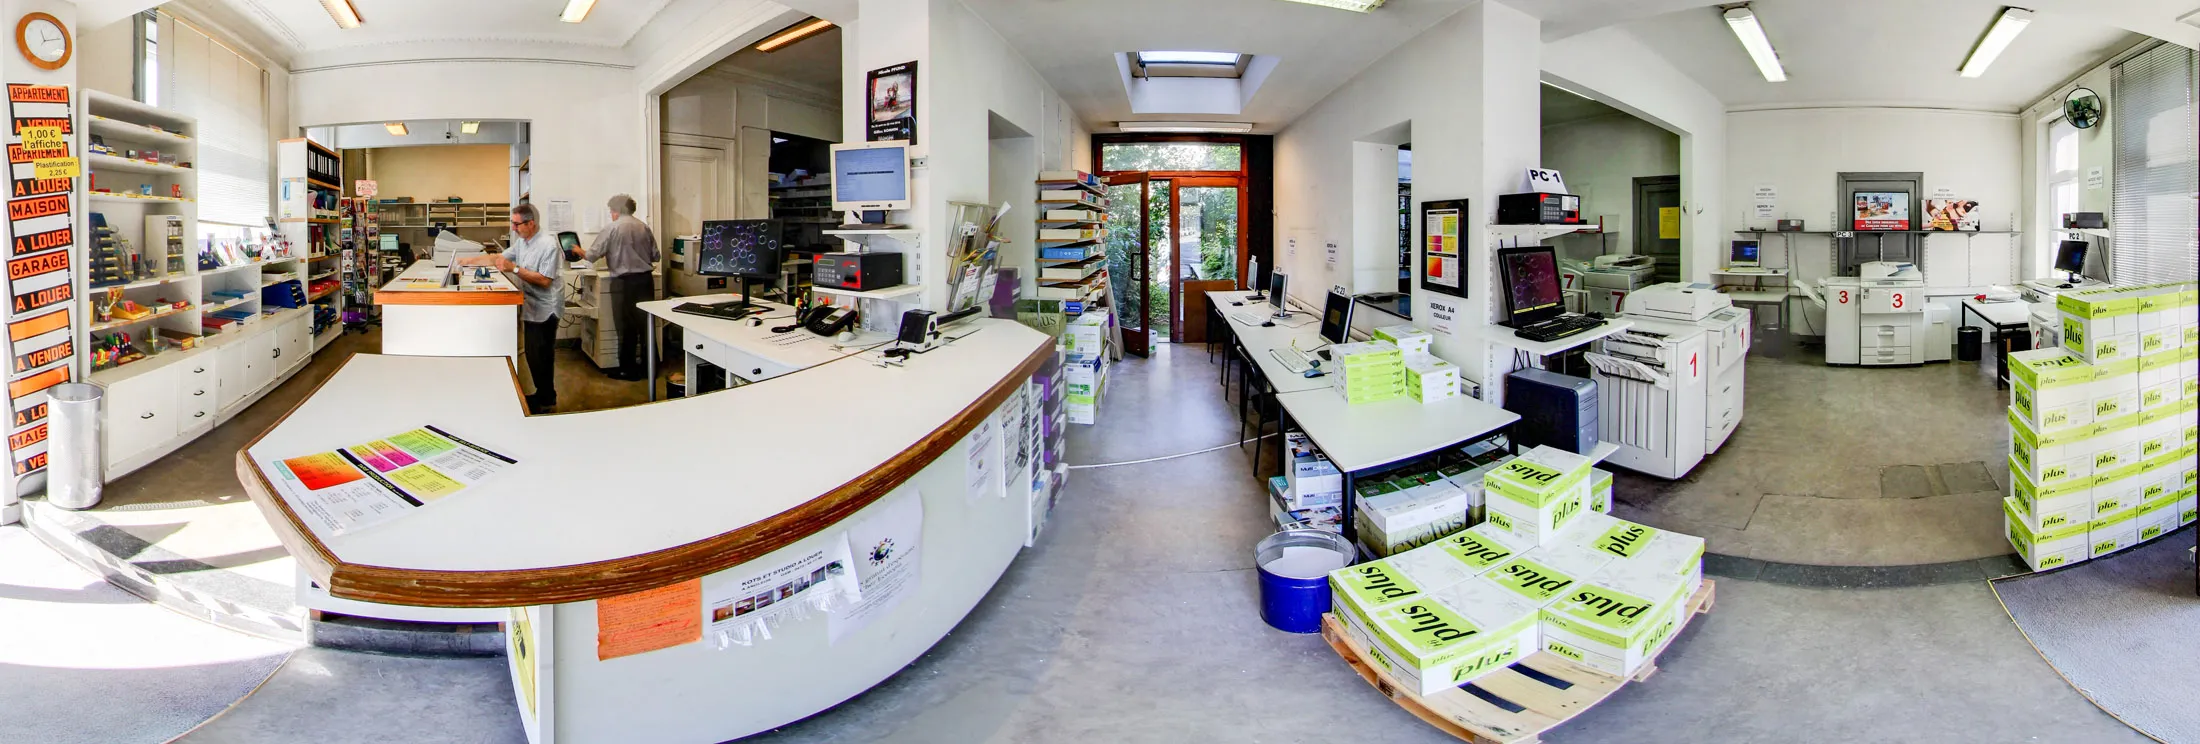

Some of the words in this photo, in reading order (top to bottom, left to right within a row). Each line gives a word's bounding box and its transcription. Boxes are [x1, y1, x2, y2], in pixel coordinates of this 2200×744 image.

[12, 87, 66, 100] APPARTEMENT
[16, 119, 23, 133] A
[27, 119, 71, 133] VENDRE
[28, 129, 48, 140] 1,00
[50, 129, 56, 138] €
[24, 140, 62, 149] l'affiche
[12, 147, 66, 160] APPARTEMENT
[1530, 169, 1549, 182] PC
[1553, 172, 1560, 183] 1
[16, 181, 26, 196] A
[30, 178, 71, 194] LOUER
[12, 198, 67, 217] MAISON
[16, 238, 26, 253] A
[30, 229, 71, 250] LOUER
[2069, 232, 2076, 240] PC
[12, 254, 67, 276] GARAGE
[1563, 274, 1574, 289] 7
[16, 297, 26, 312] A
[30, 284, 71, 308] LOUER
[1612, 291, 1626, 313] 7
[1839, 290, 1849, 304] 3
[1892, 294, 1903, 308] 3
[1430, 302, 1446, 312] XEROX
[1448, 306, 1455, 314] A4
[2092, 306, 2107, 316] plus
[2140, 302, 2153, 311] plus
[1433, 312, 1452, 321] COULEUR
[1740, 328, 1744, 348] 1
[2064, 325, 2082, 345] plus
[2143, 336, 2161, 350] plus
[16, 357, 26, 372] A
[28, 342, 72, 368] VENDRE
[2096, 344, 2116, 358] plus
[1690, 352, 1697, 378] 1
[2032, 356, 2074, 366] plus
[2040, 376, 2056, 386] plus
[2184, 382, 2197, 396] plu
[2015, 390, 2031, 412] plus
[2144, 393, 2161, 406] plus
[2096, 402, 2117, 416] plus
[16, 412, 26, 426] A
[2044, 414, 2066, 428] plus
[12, 427, 48, 448] MAIS
[2185, 429, 2197, 441] plu
[2038, 438, 2055, 447] plus
[2144, 442, 2161, 456] plus
[2014, 442, 2029, 464] plus
[16, 462, 26, 475] A
[2096, 455, 2116, 468] plus
[1505, 462, 1562, 482] plus
[2042, 469, 2065, 482] plus
[2184, 472, 2197, 485] plu
[1486, 480, 1501, 491] plus
[2094, 476, 2109, 486] plus
[2040, 490, 2056, 498] plus
[2144, 487, 2162, 499] plus
[1552, 497, 1580, 530] plus
[2098, 500, 2117, 514] plus
[1488, 513, 1511, 530] plus
[2042, 516, 2065, 528] plus
[1392, 516, 1463, 555] cyclus
[2036, 535, 2052, 543] plus
[2142, 528, 2159, 540] plus
[1606, 525, 1645, 558] plus
[2094, 542, 2114, 555] plus
[1453, 536, 1512, 562] plus
[2040, 557, 2062, 568] plus
[1359, 566, 1418, 600] plus
[1504, 564, 1573, 592] plus
[1572, 591, 1652, 619] plus
[1333, 608, 1348, 627] plus
[1401, 605, 1478, 641] plus
[1544, 614, 1567, 629] plus
[1366, 621, 1381, 636] plus
[1642, 621, 1673, 658] plus
[1548, 642, 1581, 660] plus
[1370, 649, 1392, 670] plus
[1453, 646, 1513, 683] plus
